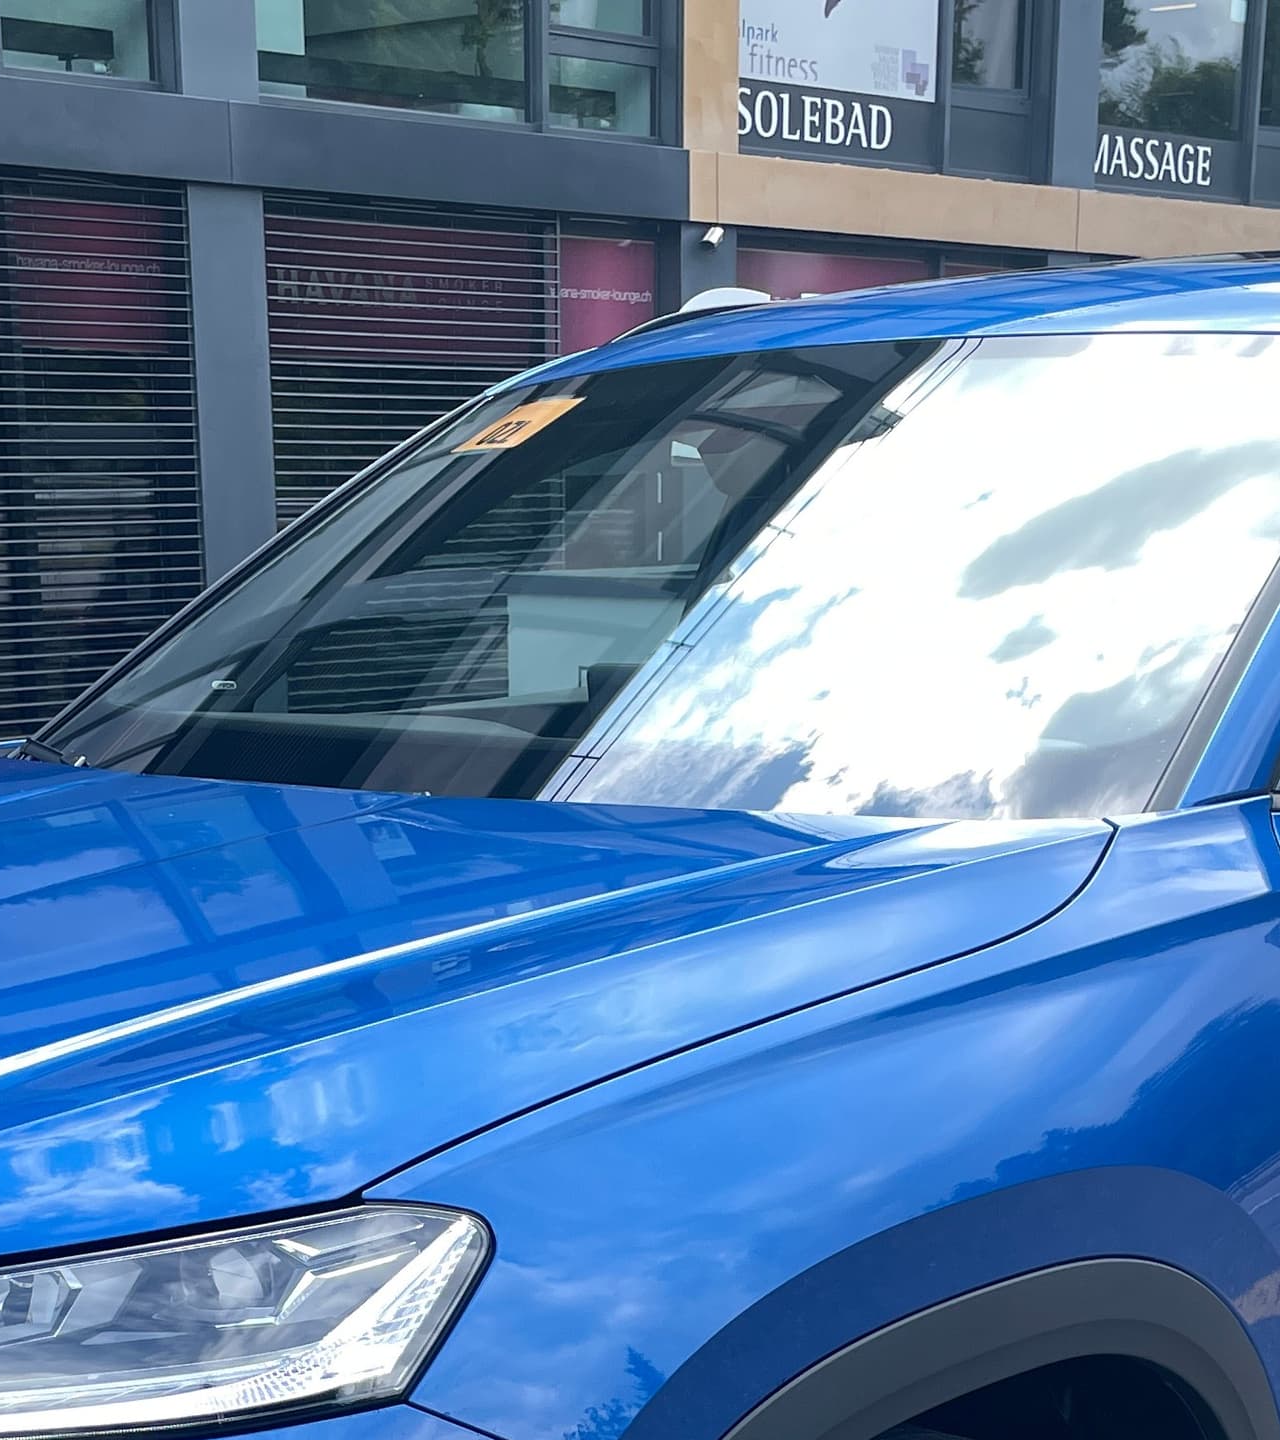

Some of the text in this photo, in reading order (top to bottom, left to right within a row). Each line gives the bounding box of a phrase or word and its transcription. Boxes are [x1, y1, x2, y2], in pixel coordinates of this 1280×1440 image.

[739, 19, 778, 46] lpark
[750, 43, 818, 82] fitness
[738, 86, 892, 150] SOLEBAD
[276, 268, 418, 310] HAVANA
